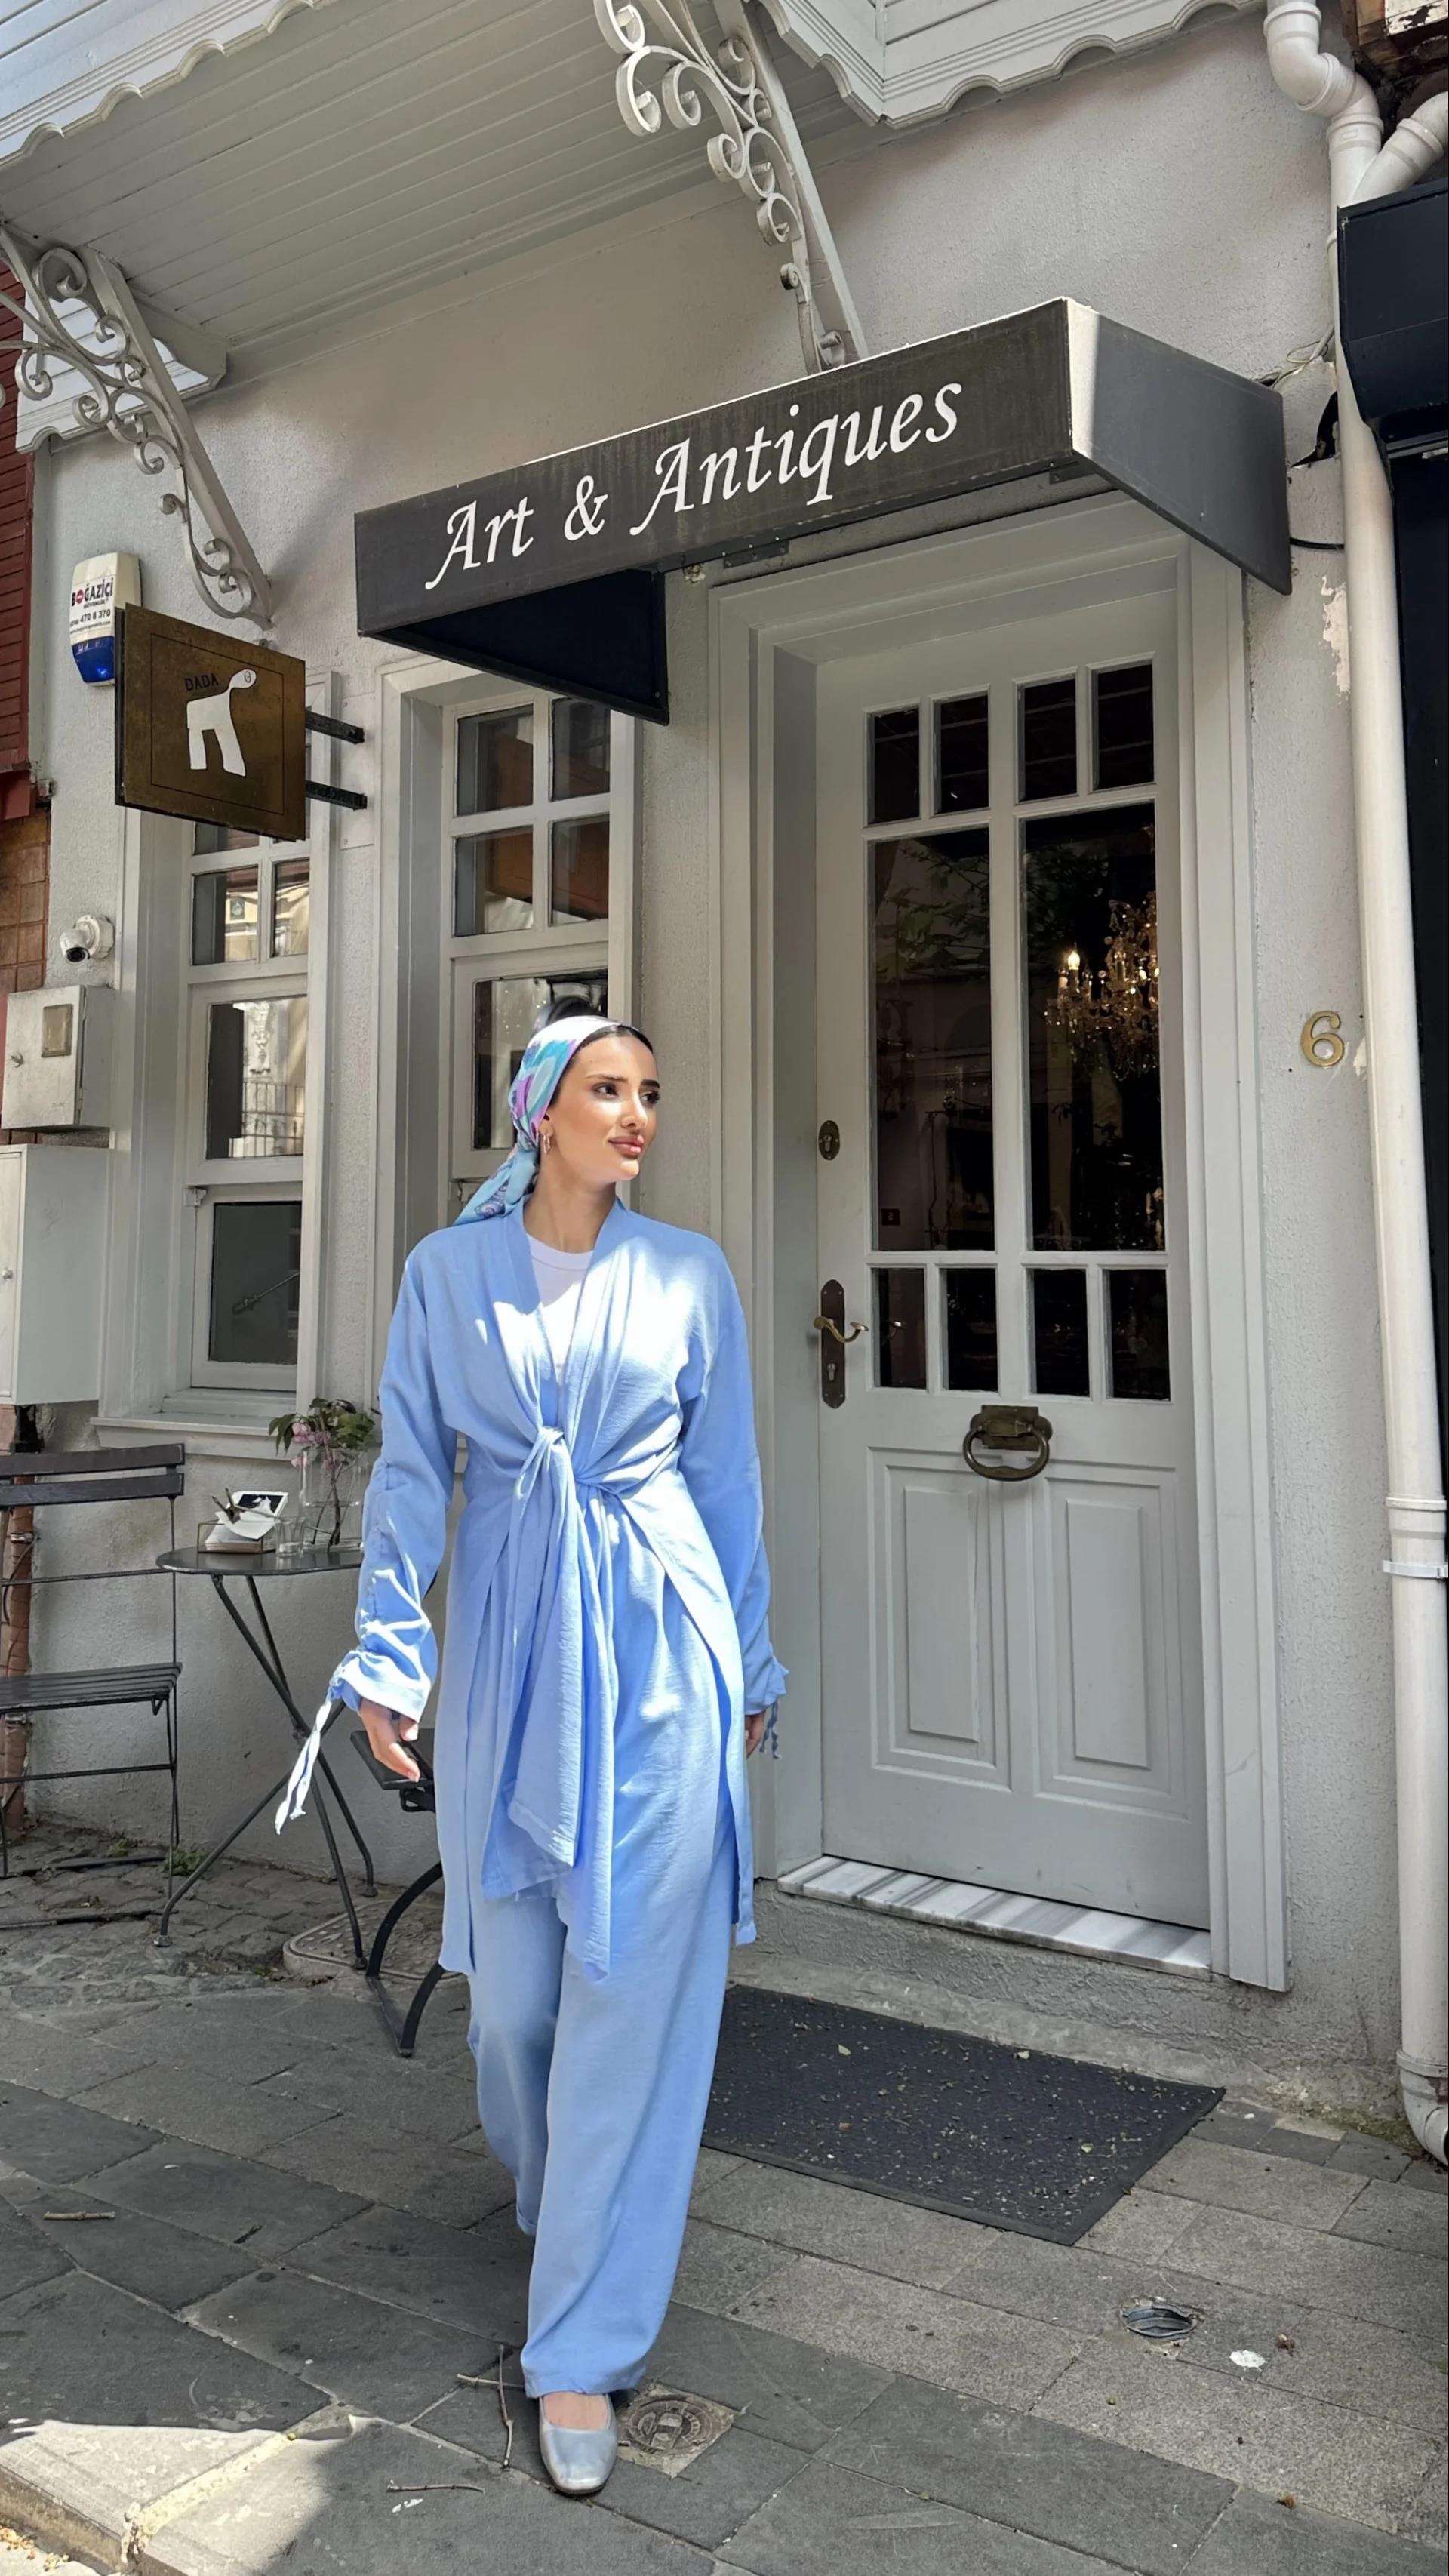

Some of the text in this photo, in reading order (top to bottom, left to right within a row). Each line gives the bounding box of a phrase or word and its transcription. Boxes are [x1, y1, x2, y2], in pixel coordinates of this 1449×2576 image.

[424, 383, 963, 590] Art & Antiques
[184, 672, 219, 691] DADA
[1300, 1010, 1345, 1067] 6
